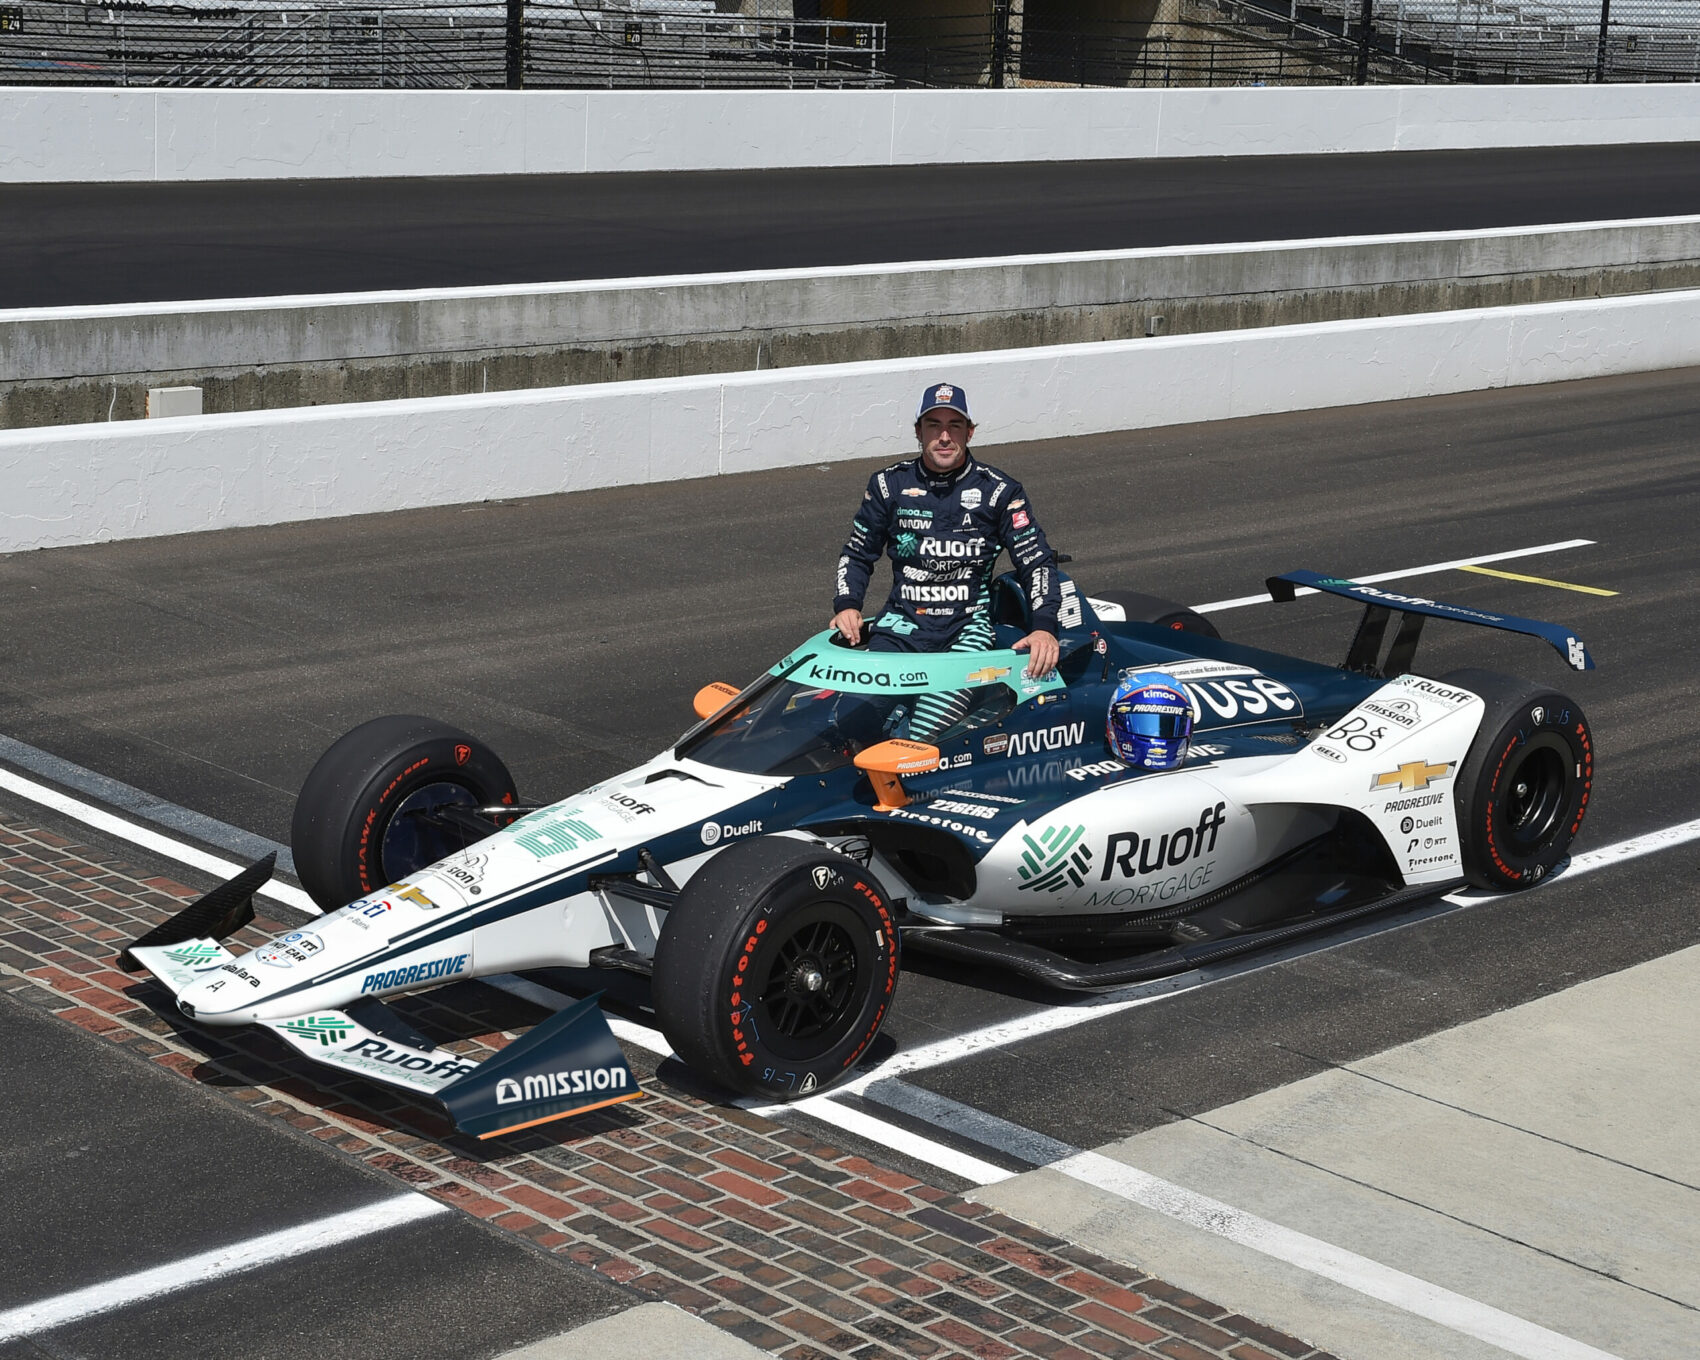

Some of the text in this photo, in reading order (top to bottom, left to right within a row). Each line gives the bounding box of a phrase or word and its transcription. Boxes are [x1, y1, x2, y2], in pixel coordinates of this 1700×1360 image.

[919, 536, 986, 557] Ruoff
[1350, 586, 1435, 606] Ruoff
[809, 664, 929, 688] kimoa.com
[1143, 691, 1176, 700] kimoa
[1414, 681, 1473, 703] Ruoff
[1132, 704, 1184, 715] PROGRESSIVE
[1007, 721, 1085, 757] ARROW
[1317, 746, 1341, 761] BELL
[609, 792, 656, 815] uoff
[1384, 792, 1445, 813] PROGRESSIVE
[723, 820, 762, 838] Duelit
[889, 809, 996, 843] Firestone
[1416, 816, 1443, 829] Duelit
[1101, 801, 1226, 881] Ruoff
[1408, 853, 1454, 868] Firestone
[1084, 861, 1216, 907] MORTGAGE
[349, 900, 387, 918] citi
[854, 881, 896, 995] FIREHAWK
[361, 954, 468, 993] PROGRESSIVE
[731, 919, 768, 1067] Firestone
[319, 1051, 442, 1088] MORTGAGE
[343, 1038, 472, 1079] Ruoff
